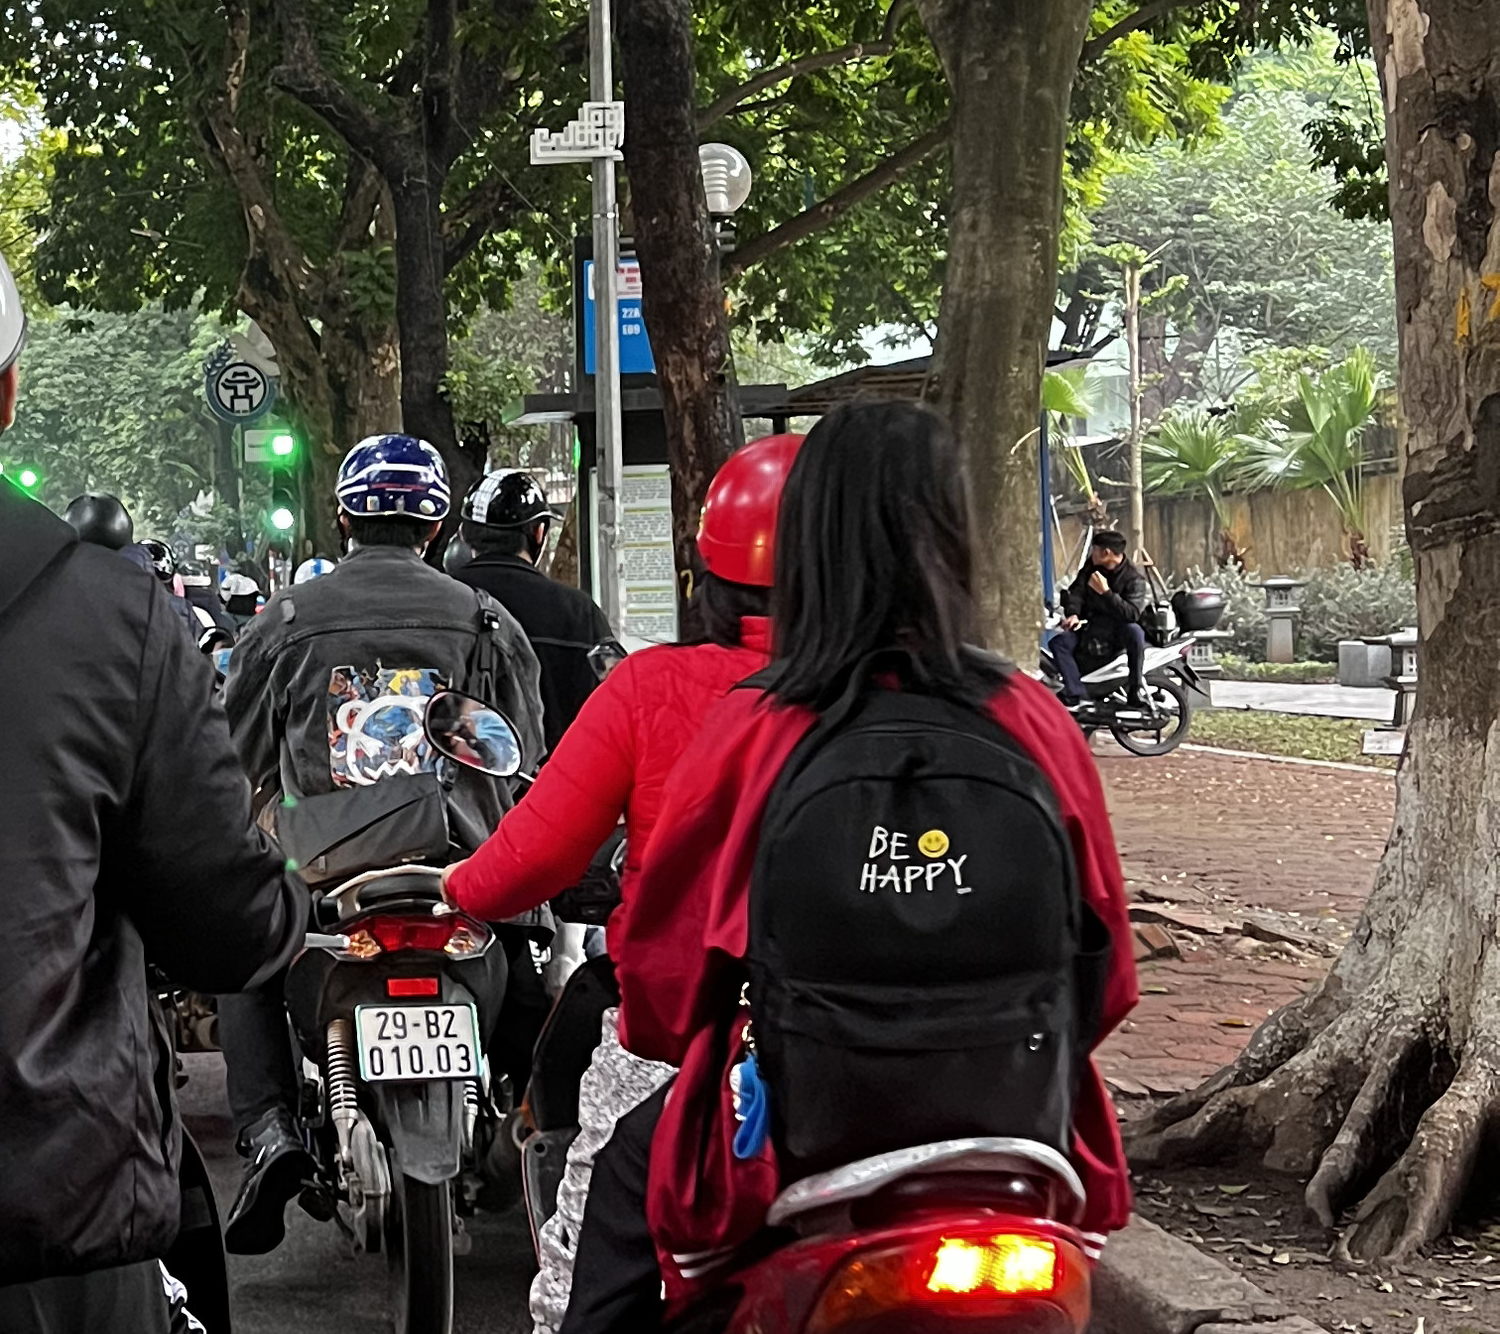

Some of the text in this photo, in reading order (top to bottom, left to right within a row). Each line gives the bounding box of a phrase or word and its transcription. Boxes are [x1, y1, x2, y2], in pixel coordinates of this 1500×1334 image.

[868, 825, 910, 860] BE
[860, 854, 968, 894] HAPPY
[375, 1010, 458, 1041] 29-B2
[369, 1043, 471, 1076] 010.03
